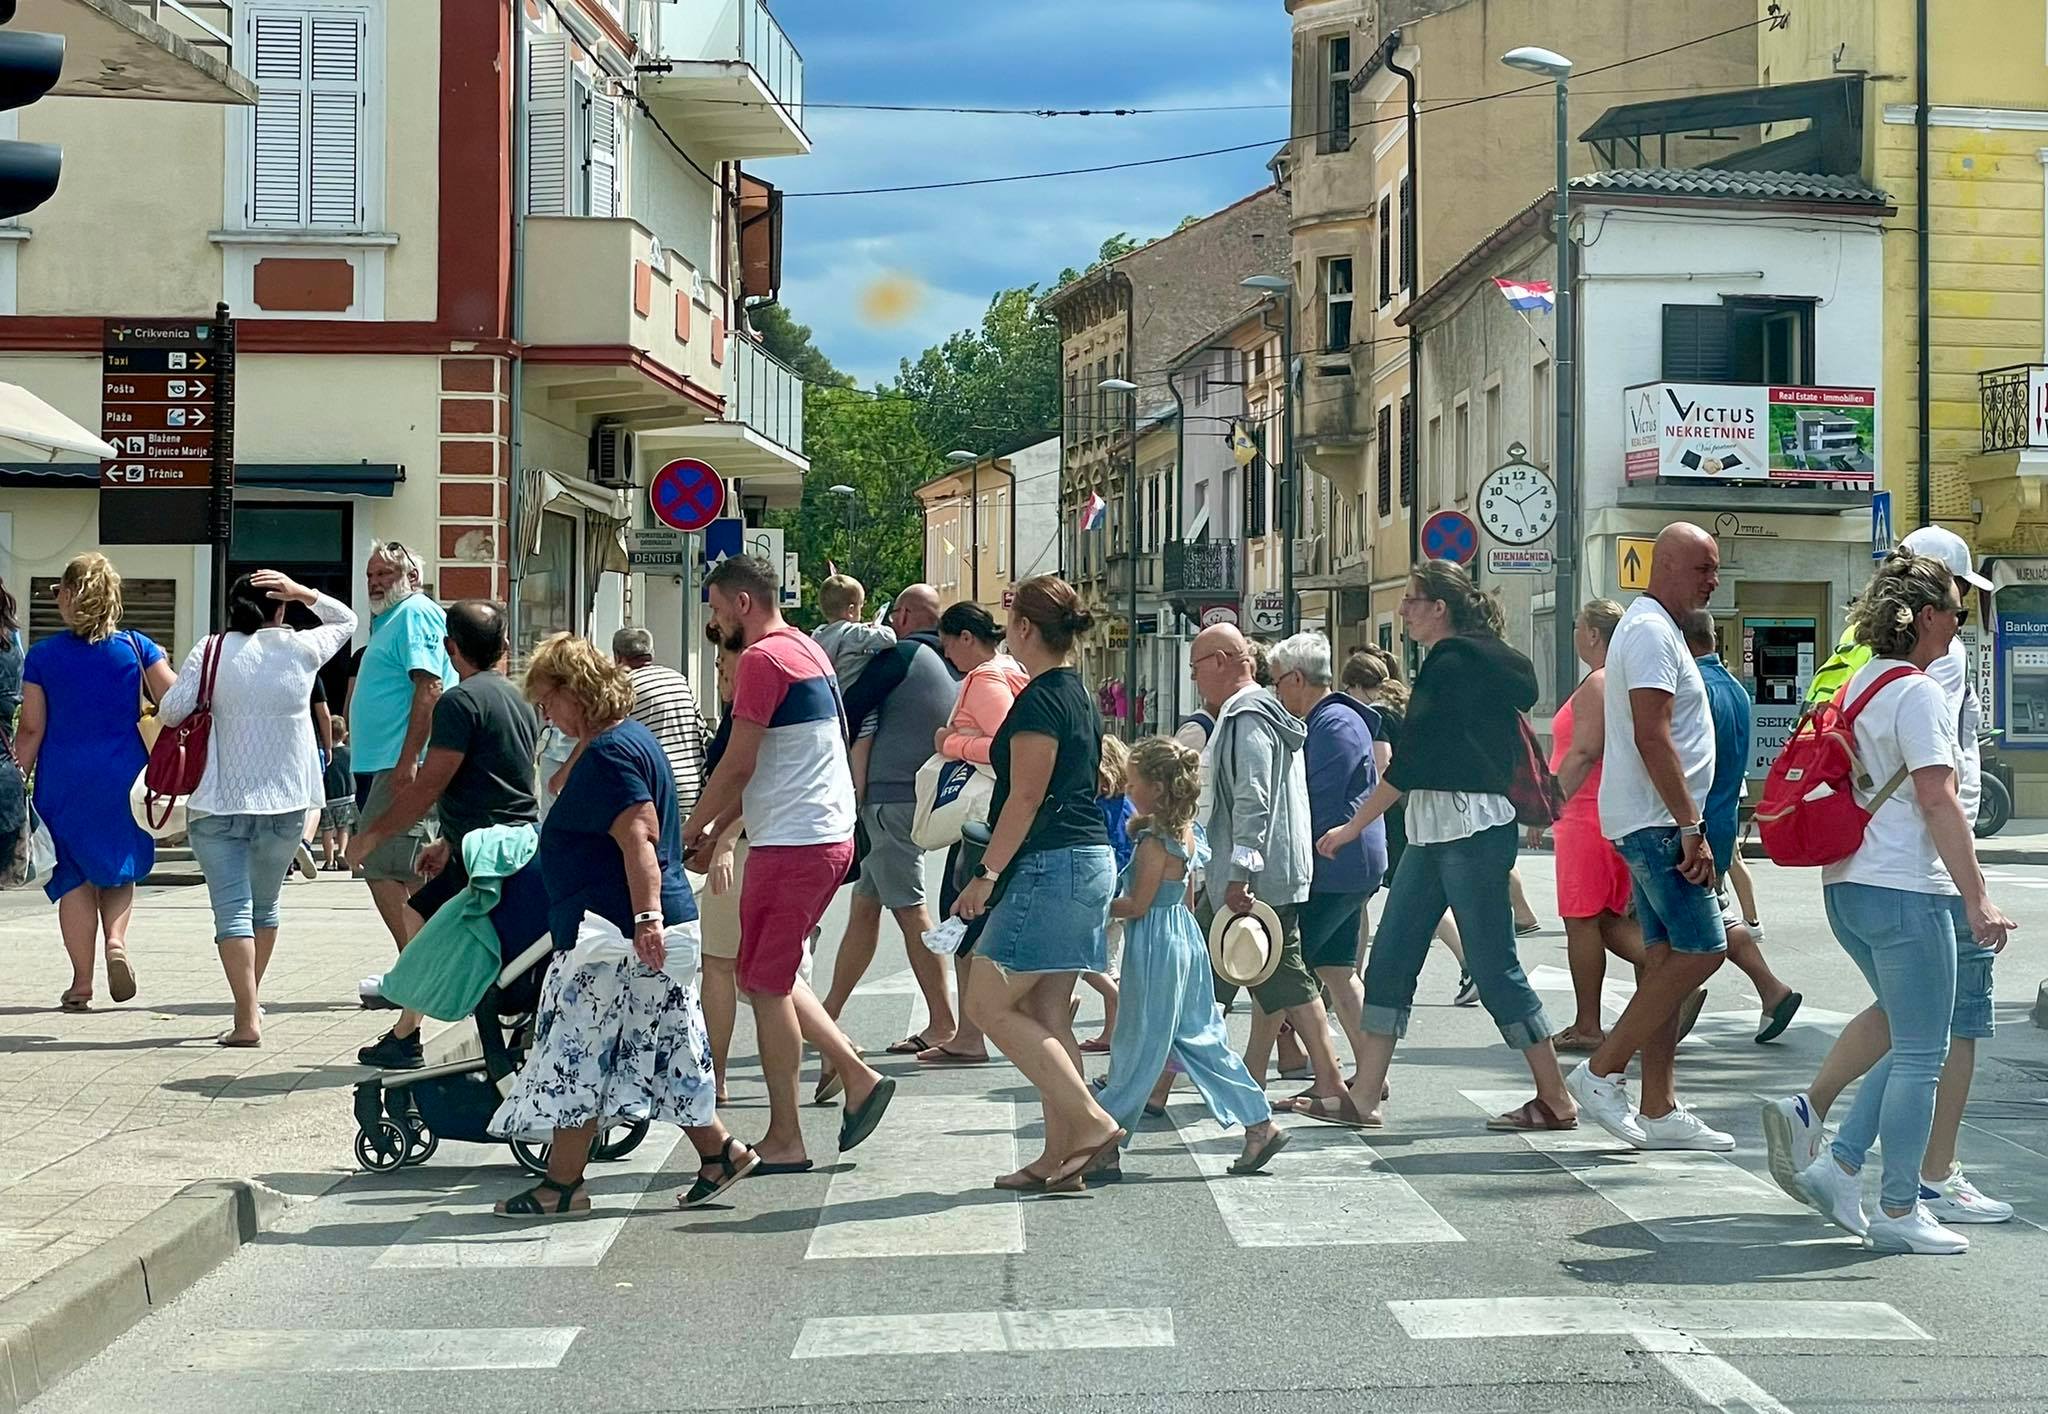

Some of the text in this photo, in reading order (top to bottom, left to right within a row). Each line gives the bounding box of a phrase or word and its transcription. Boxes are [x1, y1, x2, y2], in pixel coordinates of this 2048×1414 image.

[134, 328, 190, 338] Crikvenica
[108, 355, 128, 365] Taxi
[107, 383, 135, 393] Pošta
[1779, 391, 1864, 403] Real Estate Immobilien
[1666, 388, 1755, 423] VICTUS
[106, 411, 132, 422] Plaža
[1665, 425, 1755, 439] NEKRETNINE
[148, 433, 181, 443] Blažene
[181, 446, 208, 457] Marije
[149, 468, 184, 478] Tržnica
[1512, 471, 1526, 480] 12
[1498, 477, 1510, 485] 11
[1531, 476, 1537, 485] 1
[1490, 487, 1503, 496] 10
[1540, 486, 1548, 495] 2
[1485, 500, 1493, 509] 9
[1544, 500, 1552, 509] 3
[1490, 514, 1498, 523] 8
[1540, 513, 1547, 522] 4
[1501, 524, 1508, 533] 7
[1515, 529, 1523, 537] 6
[1530, 525, 1537, 533] 5
[634, 553, 678, 563] DENTIST
[1255, 600, 1284, 609] FRIZE
[1757, 717, 1792, 727] SEIK
[1757, 737, 1785, 747] PULS
